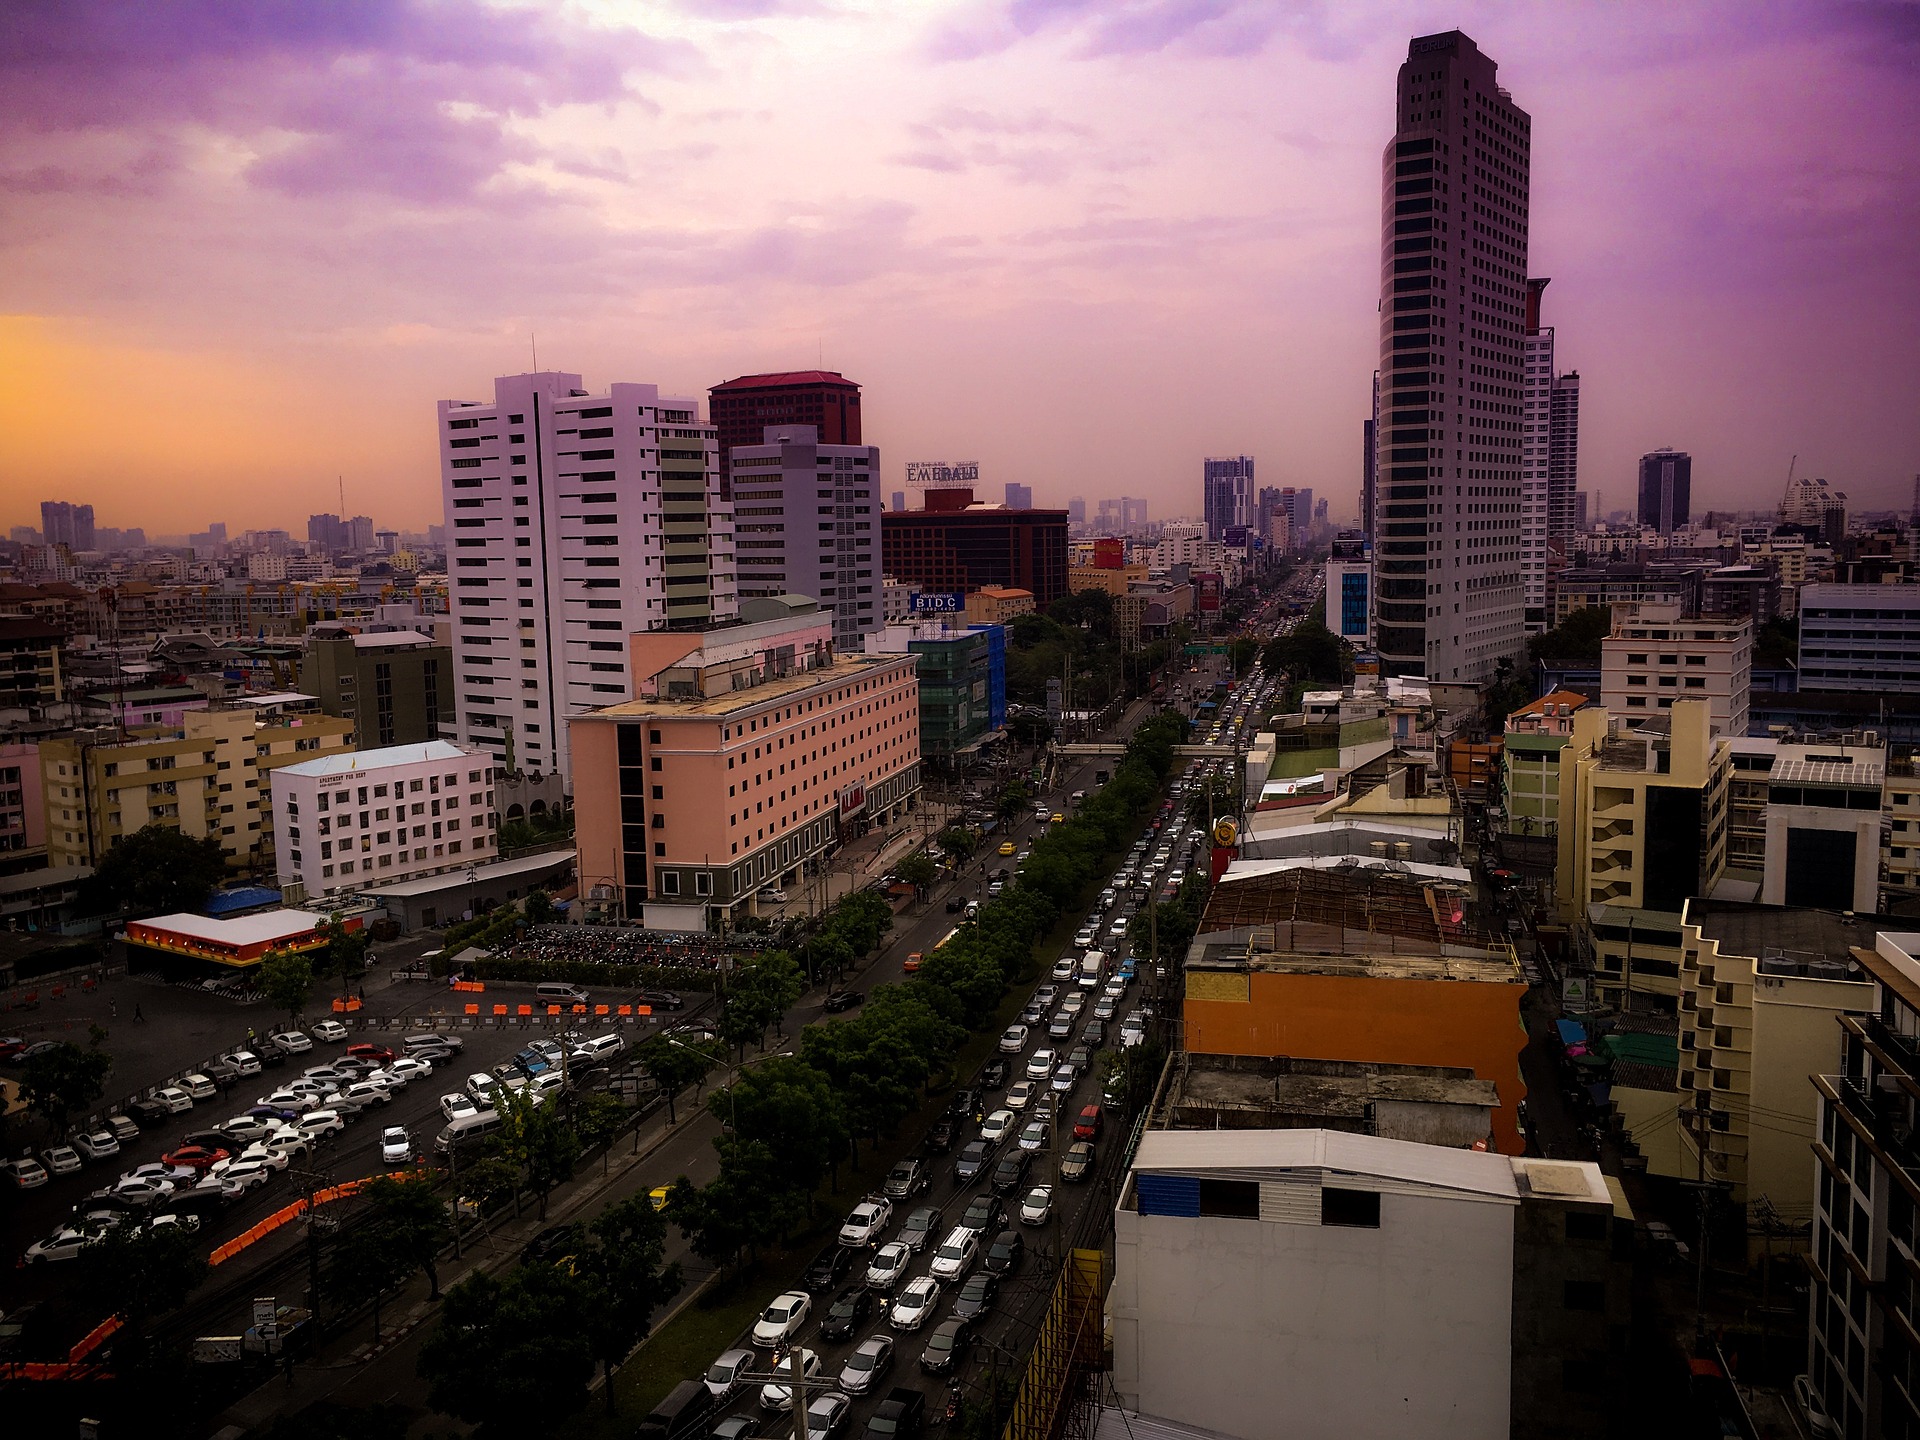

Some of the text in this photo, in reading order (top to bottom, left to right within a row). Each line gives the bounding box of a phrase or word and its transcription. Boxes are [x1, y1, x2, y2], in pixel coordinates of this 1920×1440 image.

[1413, 38, 1456, 53] FORUM
[907, 466, 979, 481] EMERALD
[916, 598, 956, 608] BIDC
[319, 775, 344, 784] APARTMENT
